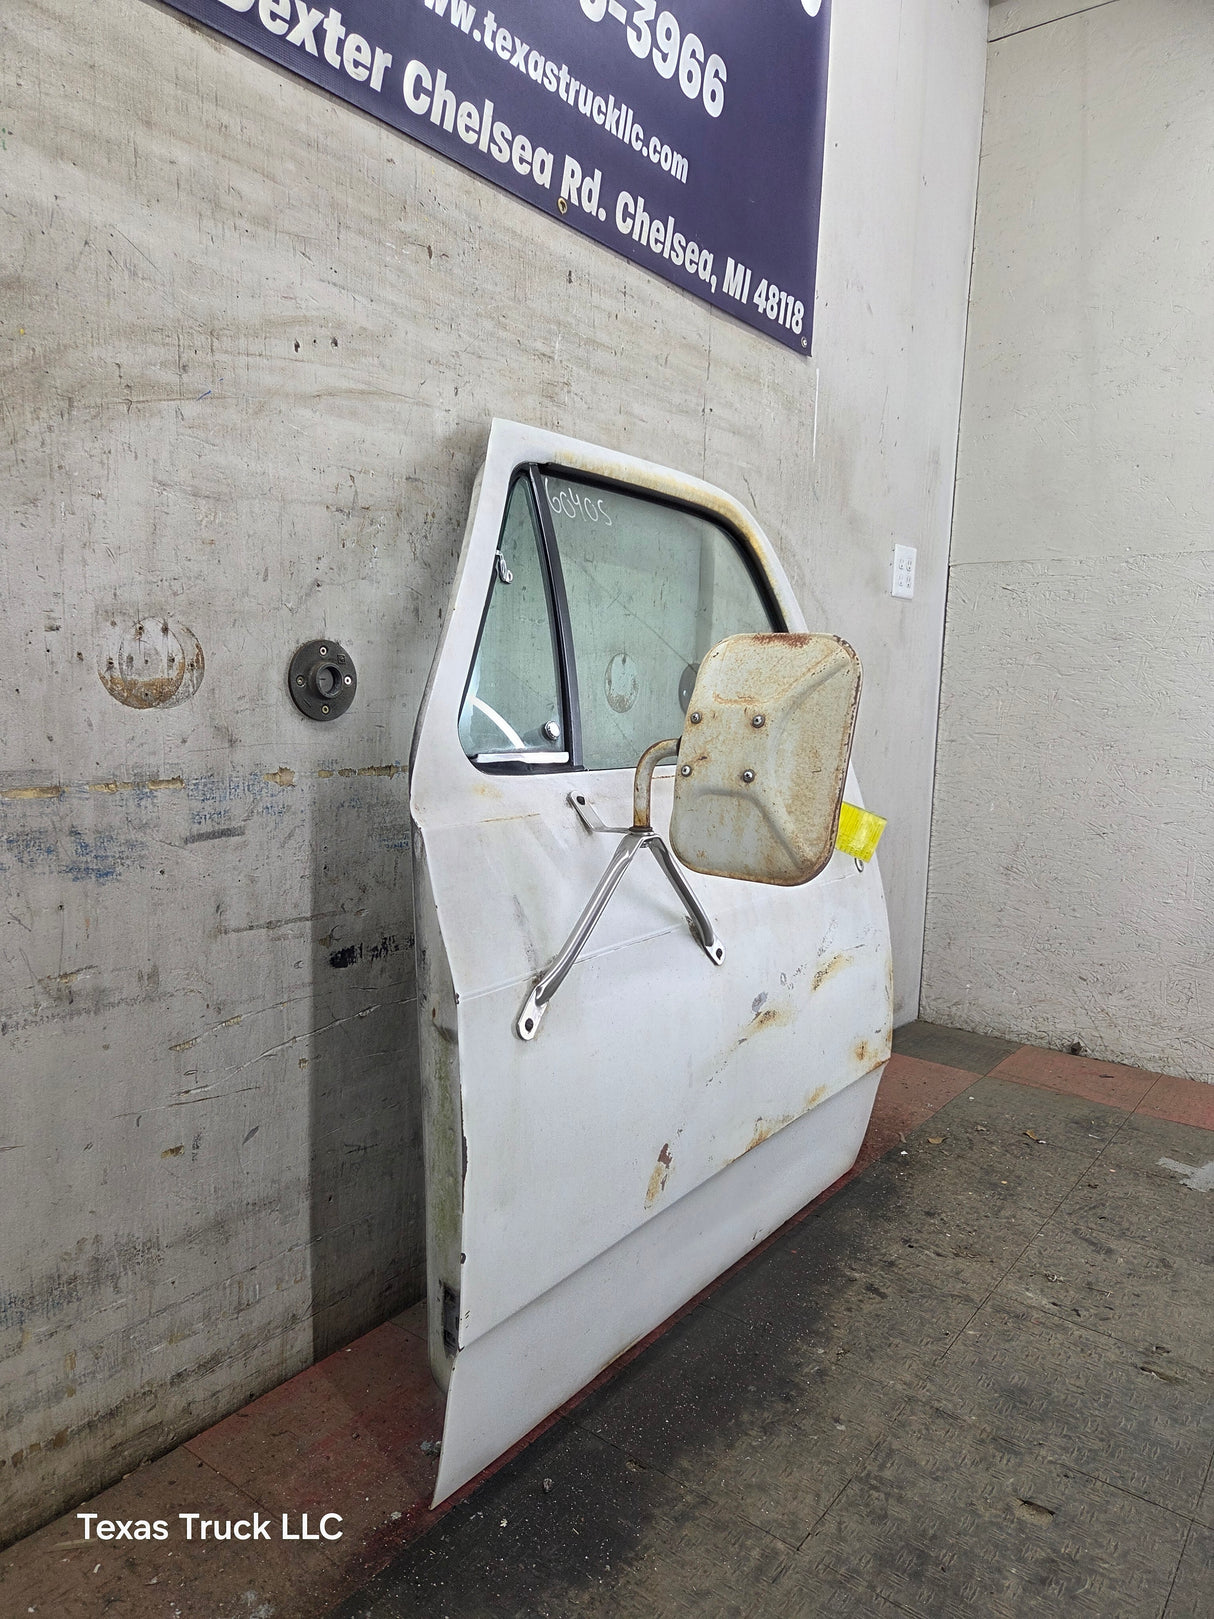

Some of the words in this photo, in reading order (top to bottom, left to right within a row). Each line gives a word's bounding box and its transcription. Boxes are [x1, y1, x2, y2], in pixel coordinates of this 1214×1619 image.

[219, 0, 393, 92] exter
[403, 59, 554, 190] Chelsea
[560, 154, 607, 221] Rd.
[616, 190, 717, 293] Chelsea,
[722, 256, 752, 304] MI
[753, 278, 805, 335] 48118
